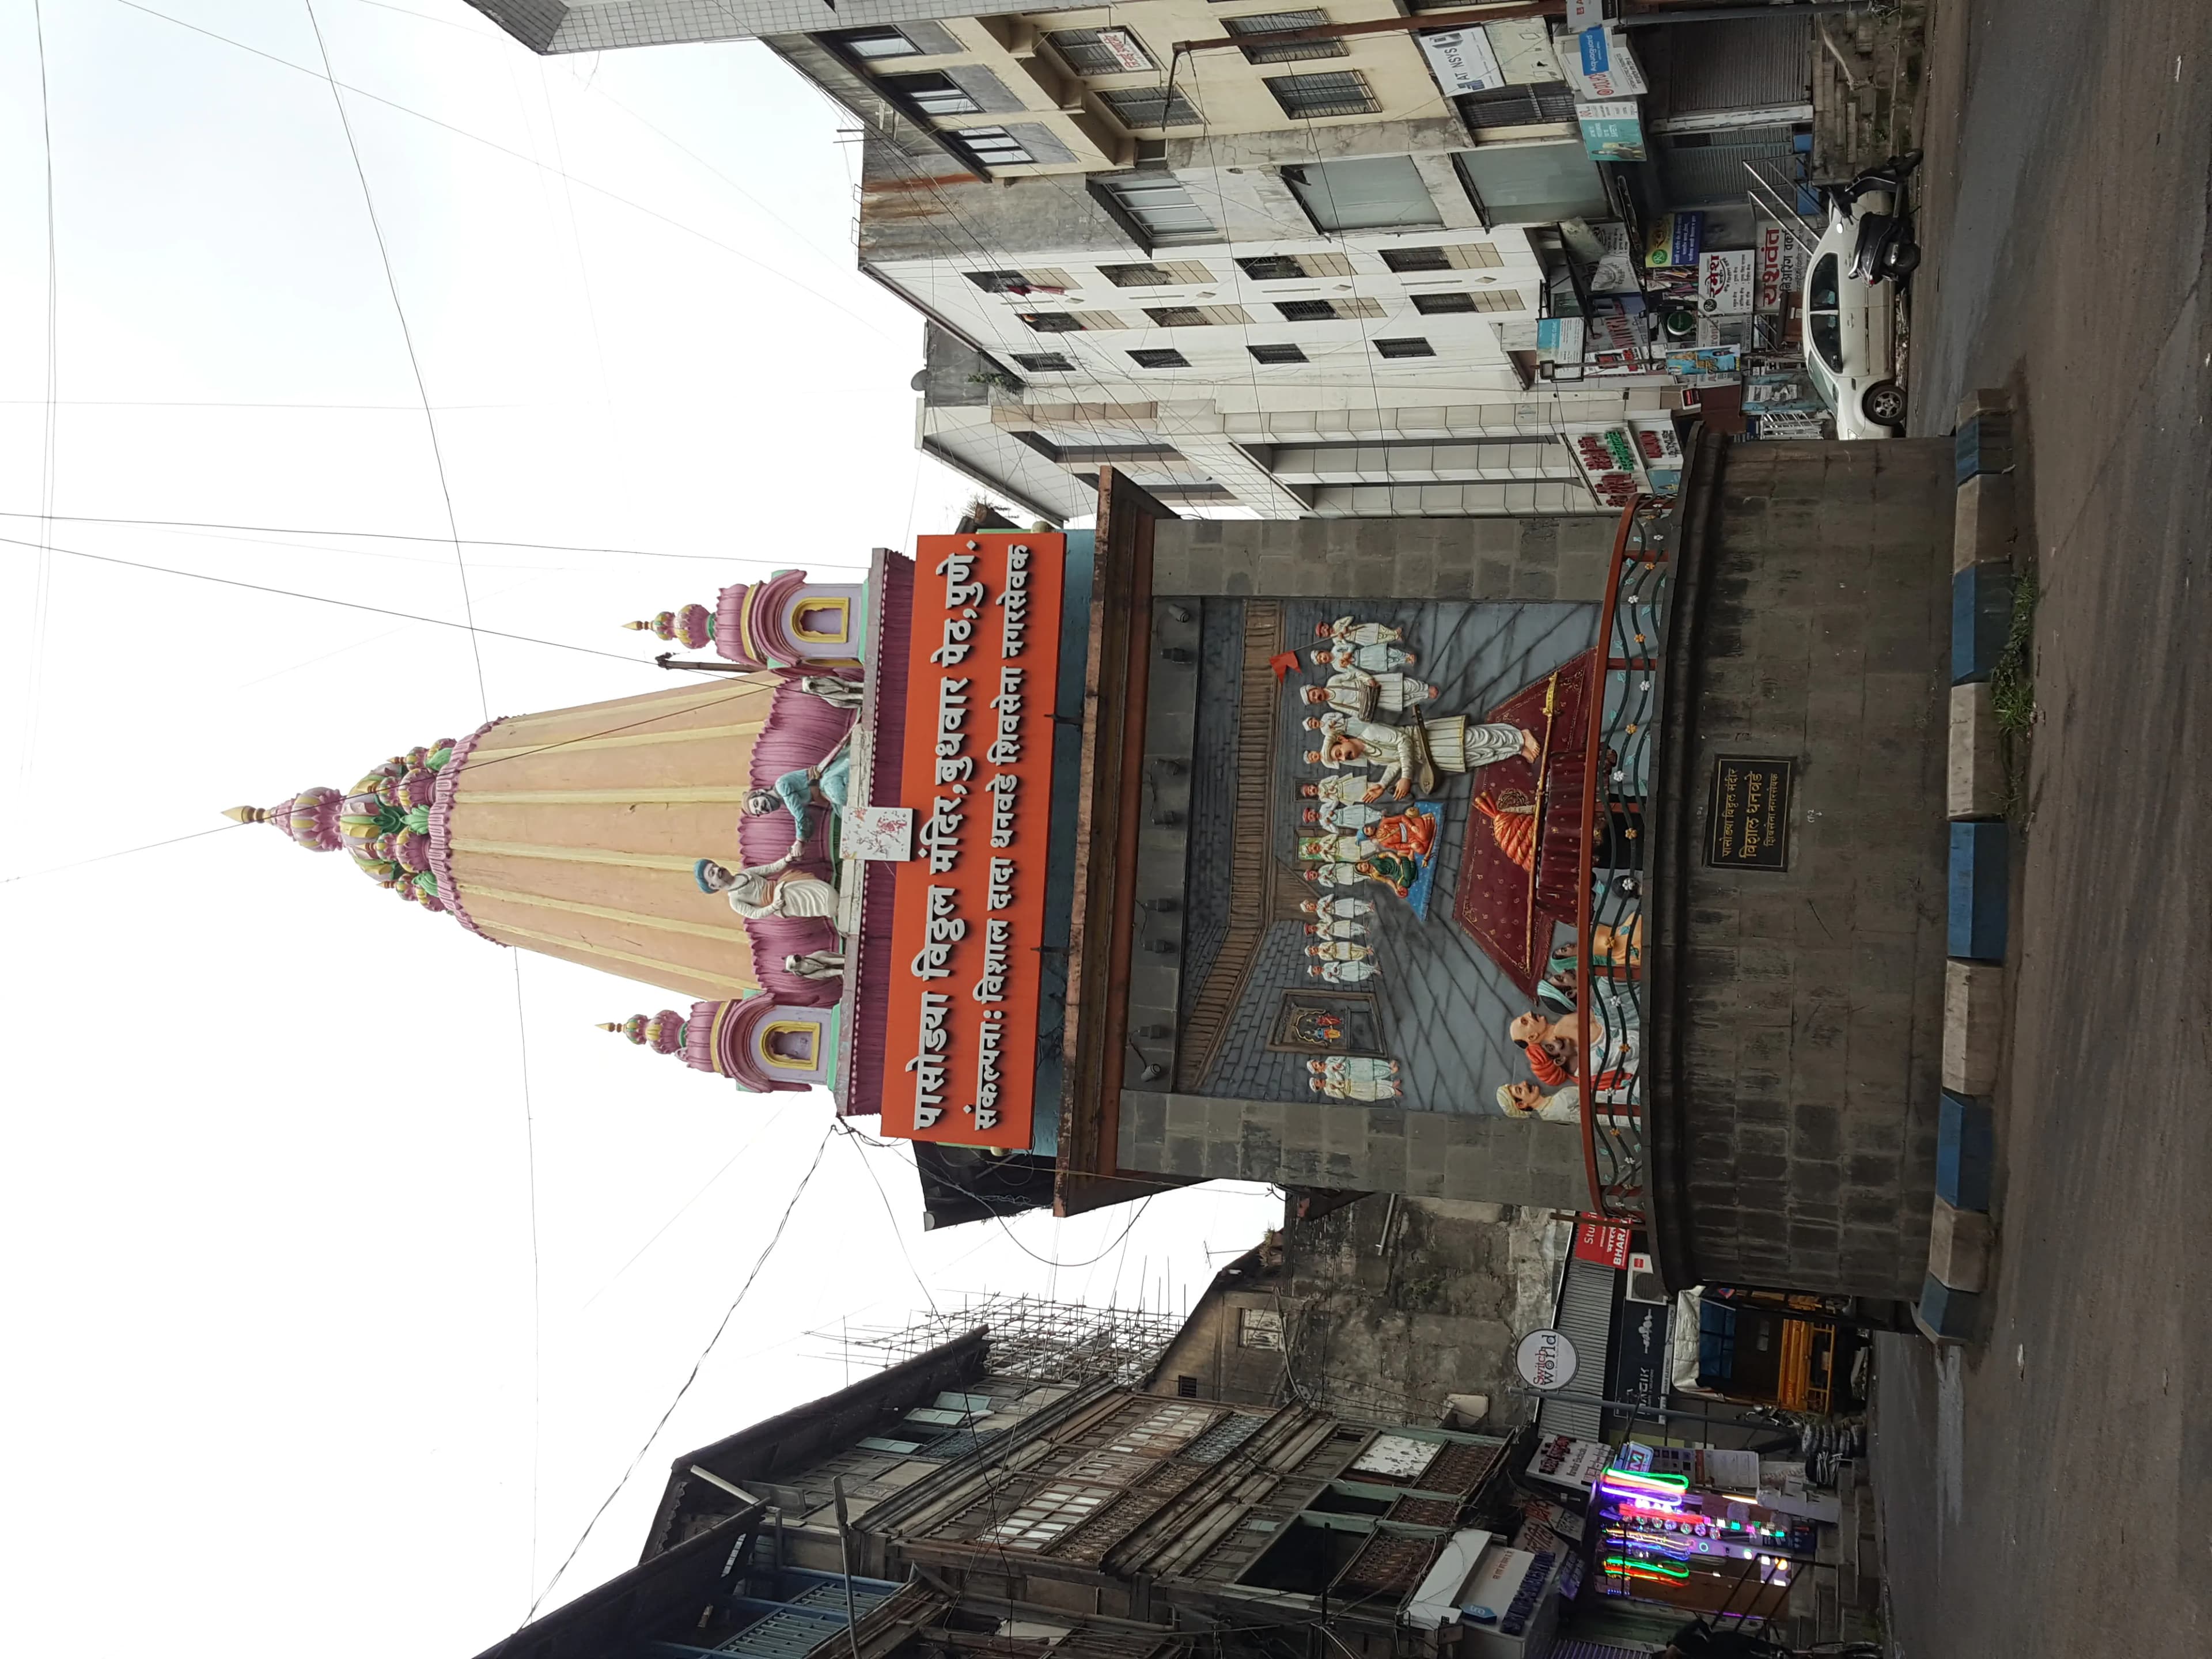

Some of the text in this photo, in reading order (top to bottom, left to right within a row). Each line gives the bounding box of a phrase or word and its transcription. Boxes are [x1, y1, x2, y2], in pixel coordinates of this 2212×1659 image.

[1586, 35, 1599, 71] Aquaguard
[1705, 255, 1722, 298] रमेश
[1761, 228, 1780, 306] यशवंत
[1779, 255, 1794, 291] निअरिंग
[995, 544, 1030, 659] नगरसेवक
[986, 665, 1023, 766] शिवसेना
[985, 773, 1018, 848] धनवडे
[1738, 771, 1762, 858] विशाल धनवडे
[1763, 772, 1778, 847] शिवसेना नगरसेवक
[987, 857, 1015, 911] दादा
[911, 885, 966, 982] विठ्ठल
[972, 918, 1010, 1004] विशाल
[1533, 1349, 1546, 1385] Switch
[1541, 1335, 1556, 1385] world
